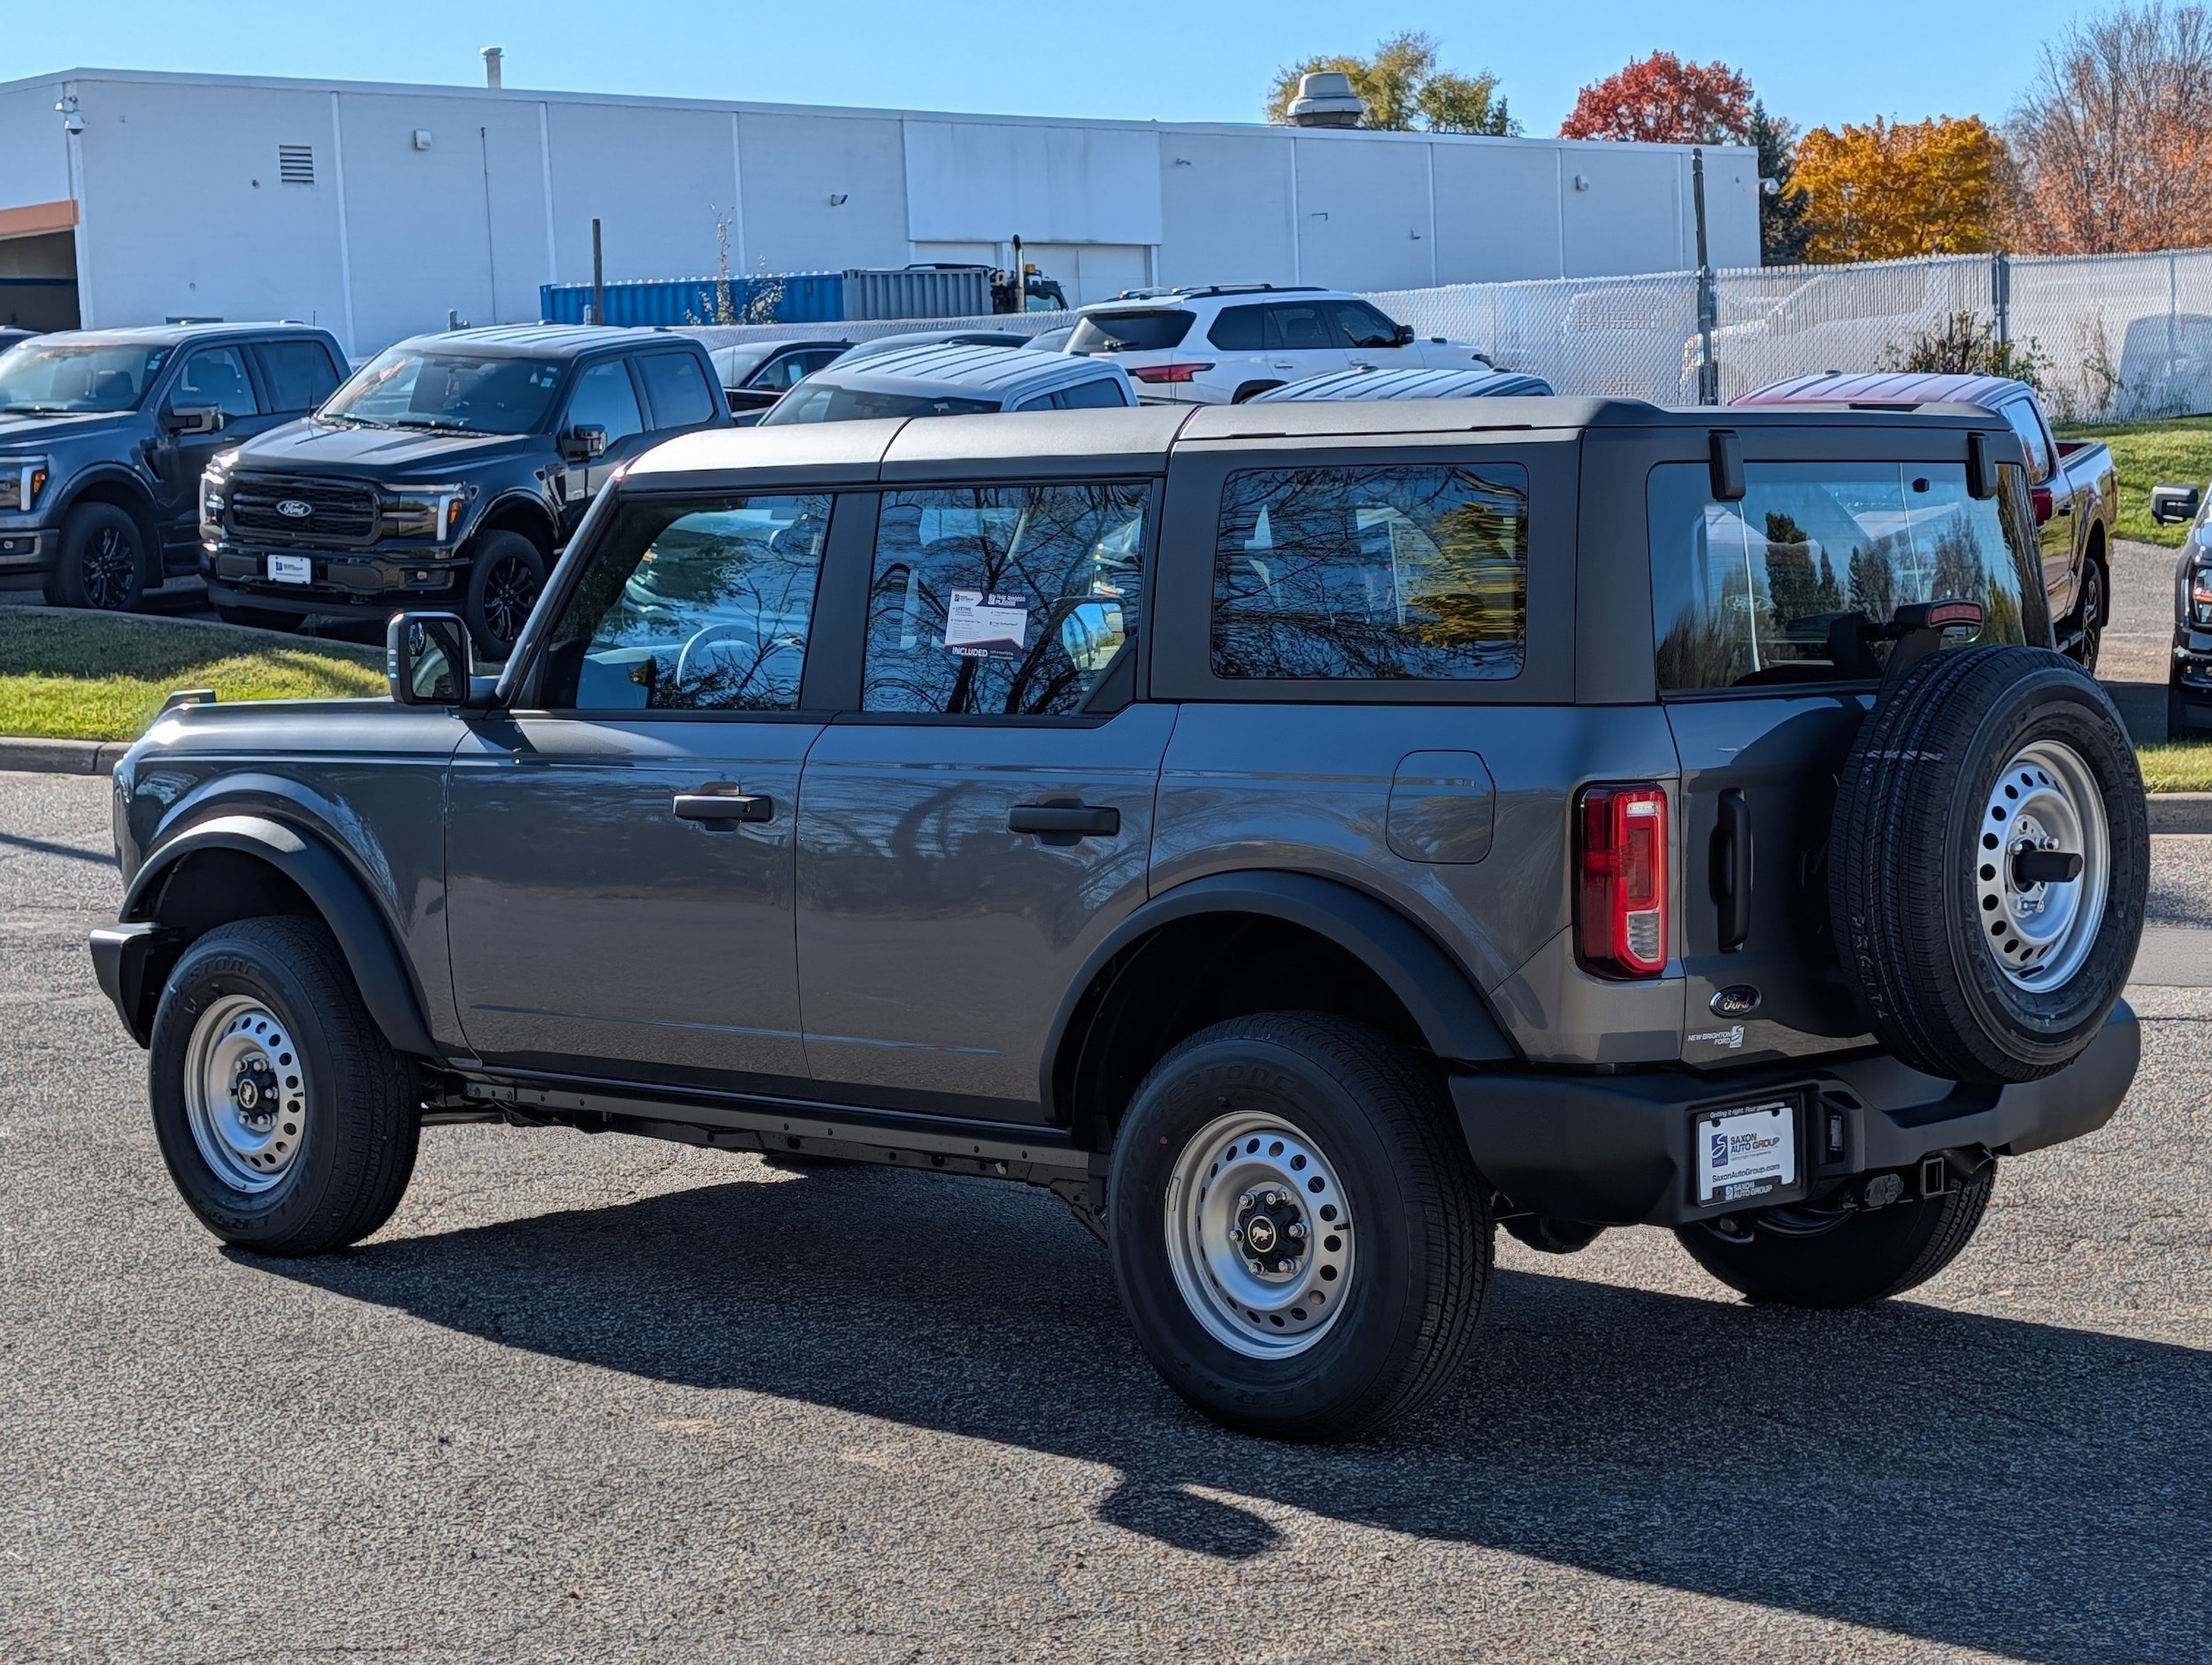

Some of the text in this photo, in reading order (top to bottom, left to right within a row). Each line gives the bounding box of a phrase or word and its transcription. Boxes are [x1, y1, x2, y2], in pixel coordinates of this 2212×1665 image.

[952, 646, 988, 657] INCLUDED
[1724, 993, 1749, 1010] Ford
[1702, 1031, 1731, 1040] BRIGHTON
[1730, 1132, 1757, 1146] SAXON
[1731, 1137, 1780, 1155] AUTO GROUP
[1712, 1163, 1781, 1183] SaxonAutoGroup.com
[1732, 1181, 1755, 1191] SAXON
[1733, 1184, 1773, 1199] AUTO GROUP
